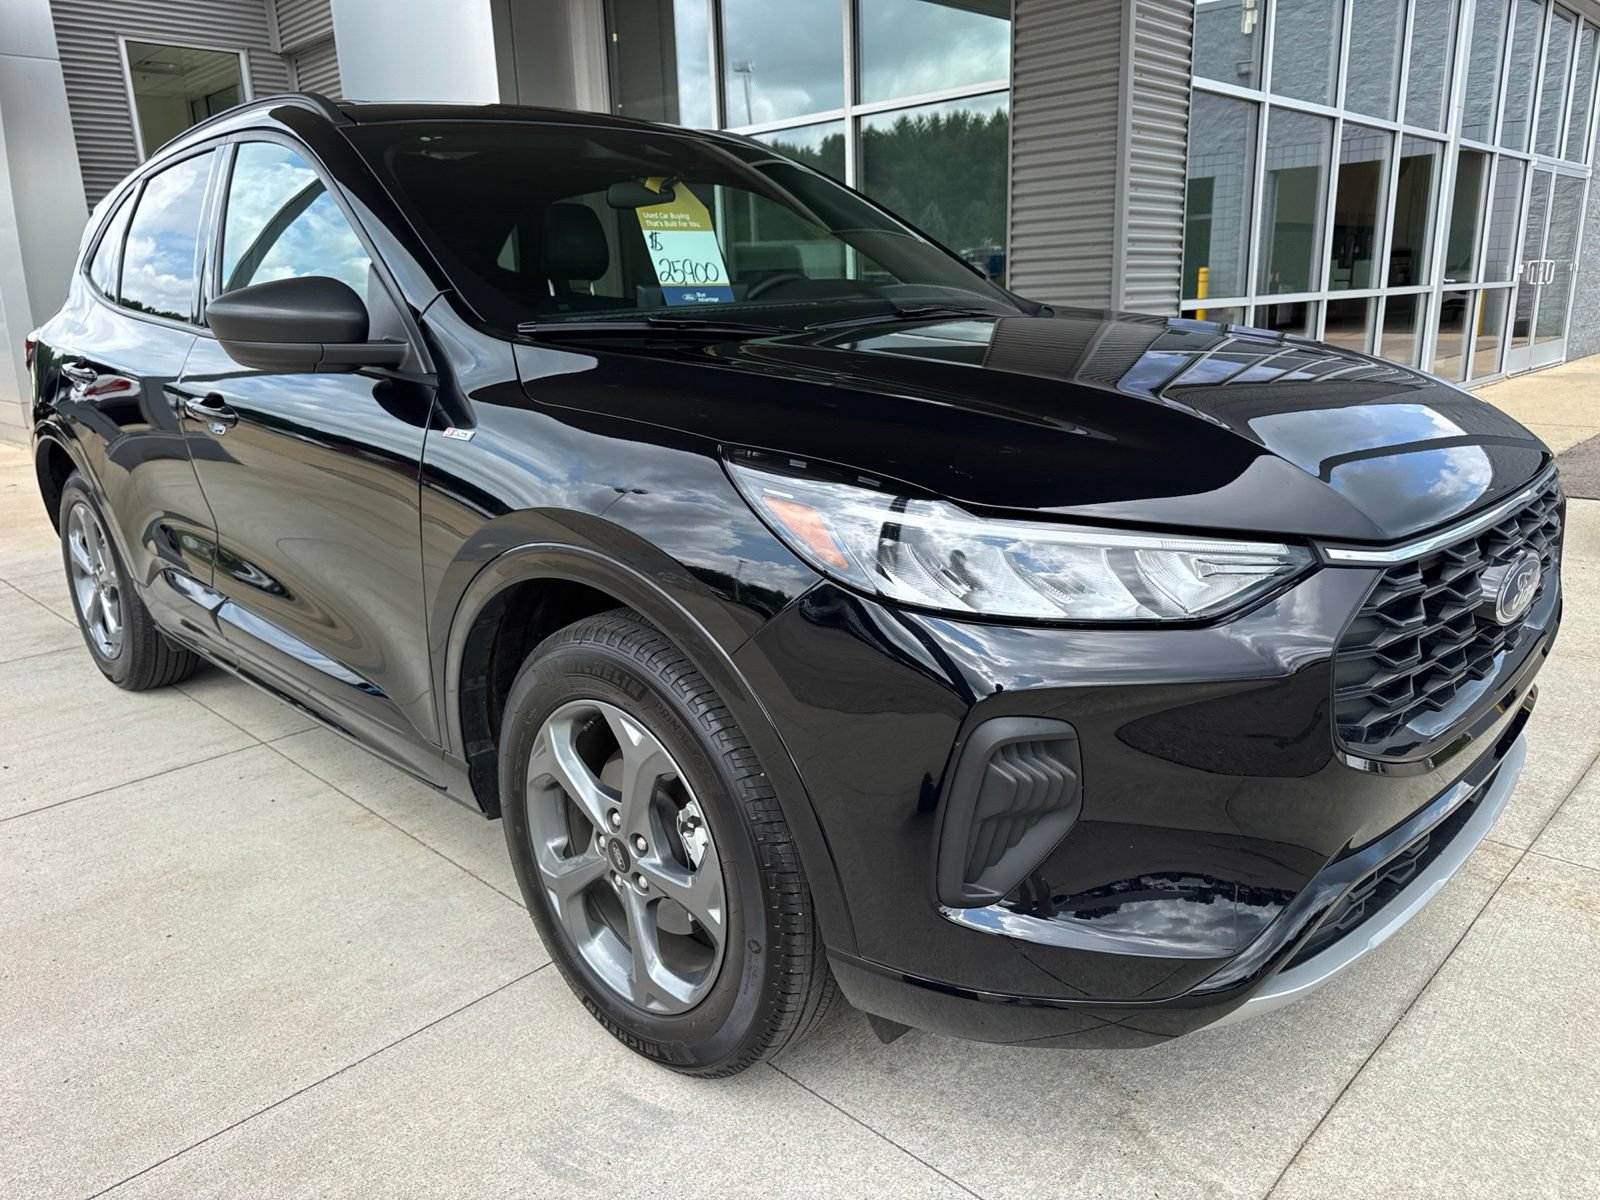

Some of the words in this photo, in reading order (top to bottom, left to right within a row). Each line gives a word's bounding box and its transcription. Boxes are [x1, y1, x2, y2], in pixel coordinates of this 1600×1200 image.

[648, 231, 664, 252] $
[566, 660, 646, 699] MICHELIN
[583, 996, 661, 1059] MICHELIN
